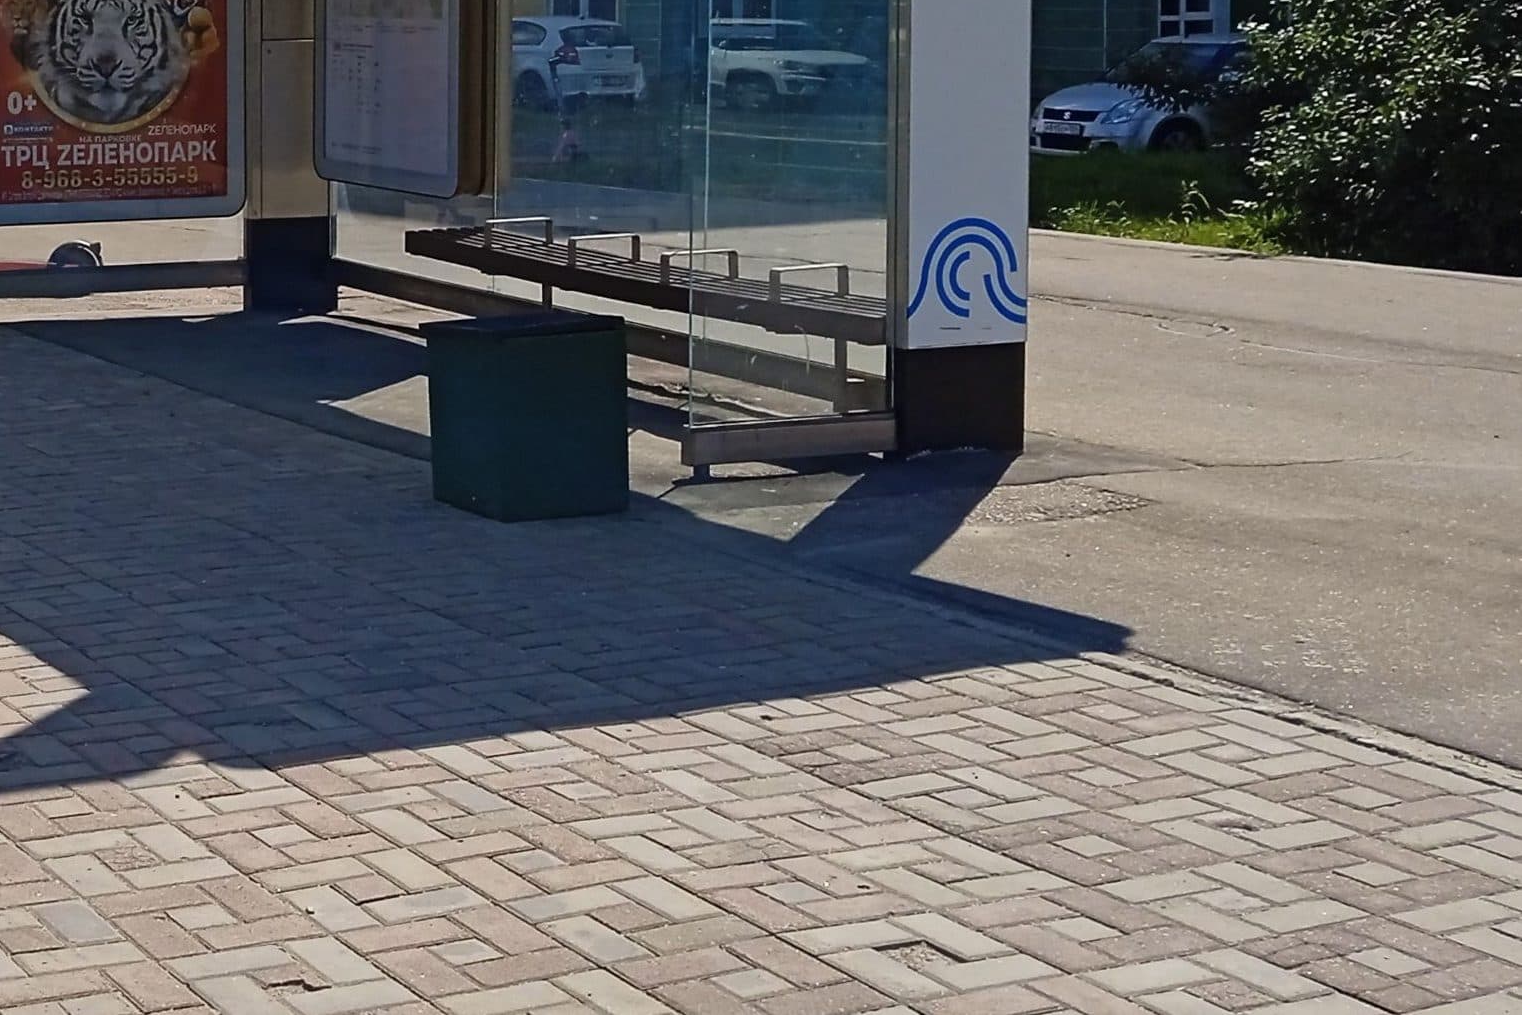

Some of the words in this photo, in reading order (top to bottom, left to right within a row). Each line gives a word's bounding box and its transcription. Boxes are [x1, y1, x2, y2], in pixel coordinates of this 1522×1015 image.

[7, 91, 37, 115] 0+
[1, 145, 50, 170] ТРЦ
[57, 140, 217, 166] ZЕЛЕНОПАРК
[21, 166, 199, 189] 8-968-3-55555-9
